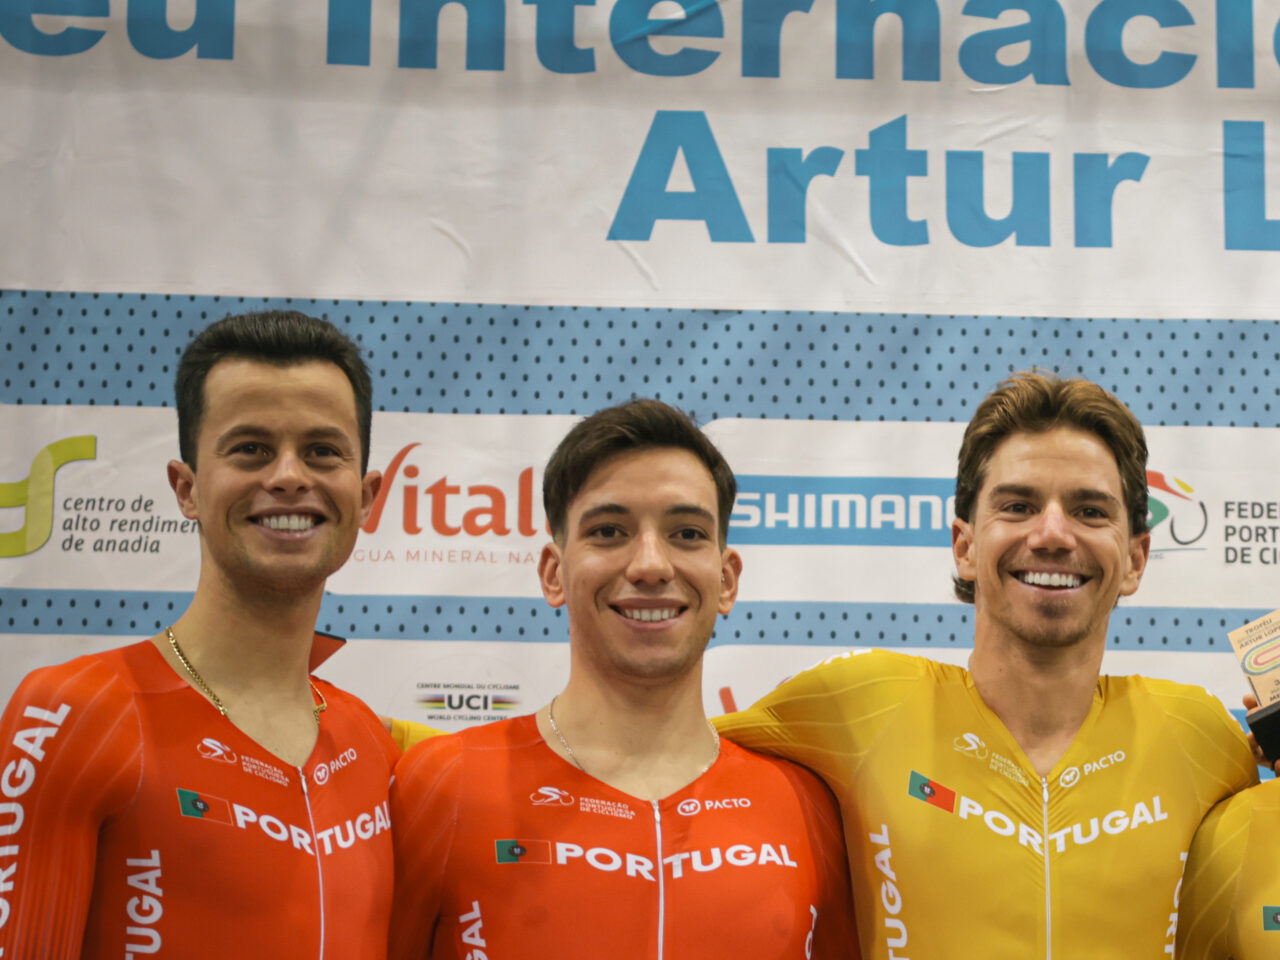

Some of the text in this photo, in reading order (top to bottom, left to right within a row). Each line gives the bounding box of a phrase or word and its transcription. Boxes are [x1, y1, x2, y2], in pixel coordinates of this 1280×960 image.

[606, 110, 1151, 248] Artur
[362, 442, 553, 537] Vital
[63, 495, 154, 512] centro de
[62, 514, 200, 533] alto rendimen
[62, 534, 160, 553] de anadia
[352, 549, 395, 563] GUA
[406, 549, 497, 564] MINERAL
[1224, 547, 1252, 564] DE
[447, 694, 489, 711] UCI
[330, 748, 357, 774] PACTO
[1083, 750, 1126, 776] PACTO
[705, 798, 751, 811] PACTO
[233, 801, 391, 856] PORTUGAL
[958, 795, 1169, 856] PORTUGAL
[555, 841, 798, 881] PORTUGAL
